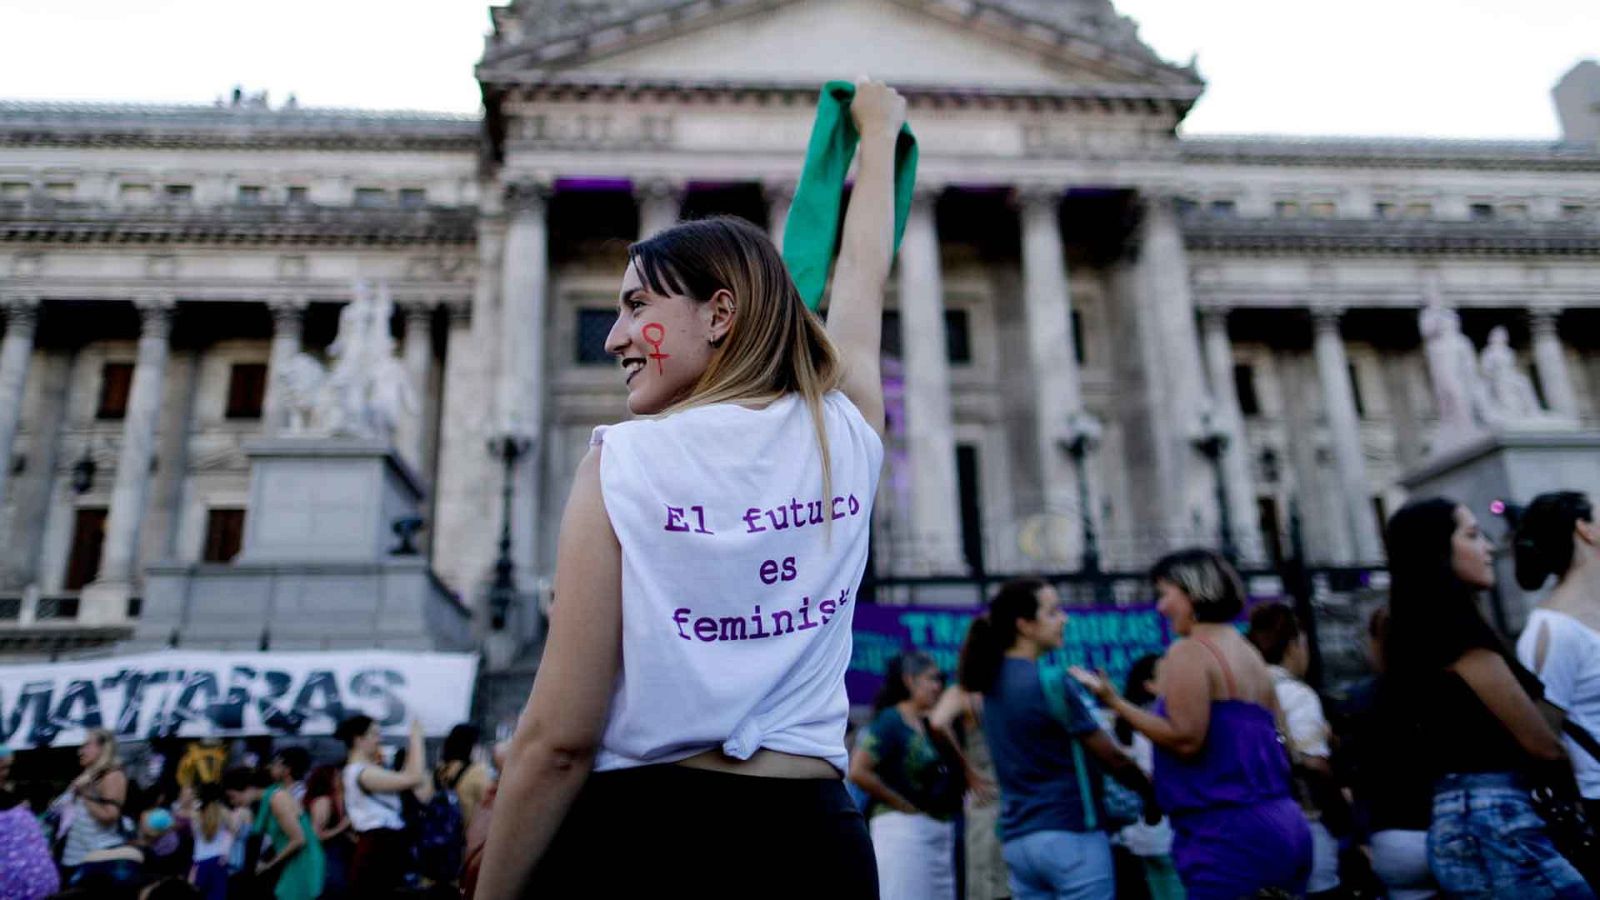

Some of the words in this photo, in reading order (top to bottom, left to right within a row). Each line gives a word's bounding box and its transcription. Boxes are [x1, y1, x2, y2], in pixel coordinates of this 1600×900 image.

[664, 505, 714, 535] El
[743, 494, 860, 533] futuro
[759, 556, 797, 585] es
[672, 587, 850, 642] feminis
